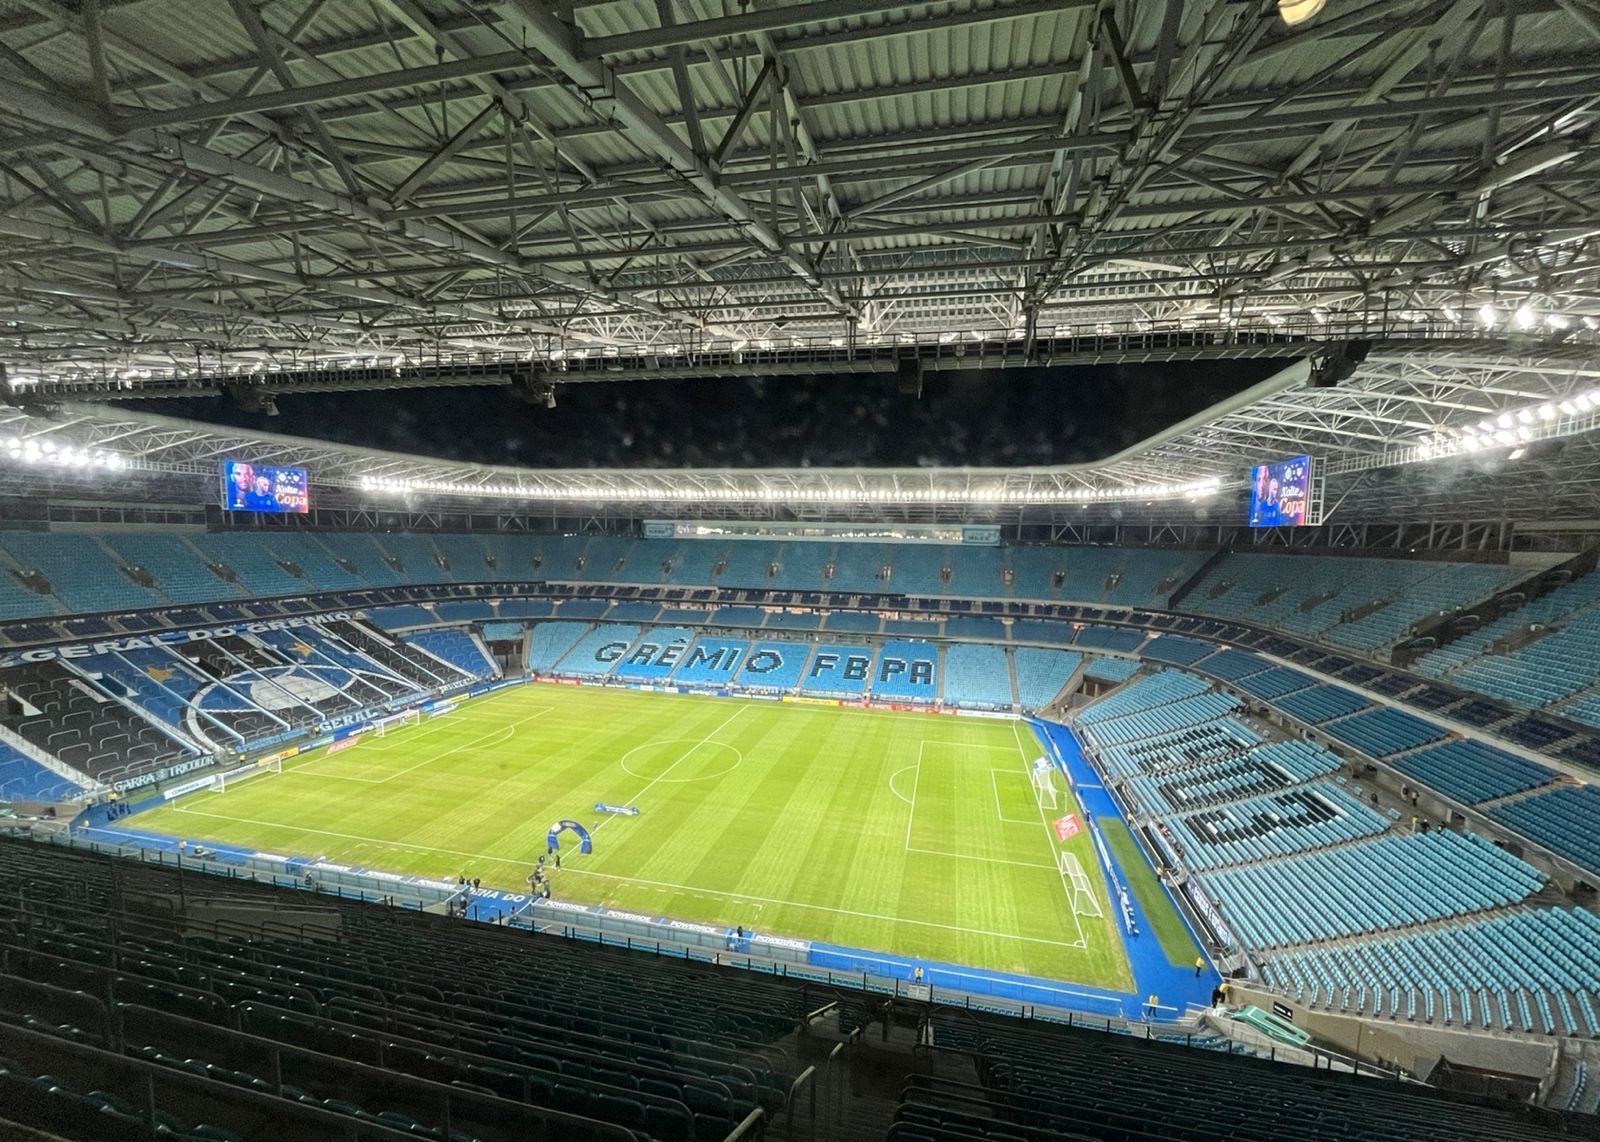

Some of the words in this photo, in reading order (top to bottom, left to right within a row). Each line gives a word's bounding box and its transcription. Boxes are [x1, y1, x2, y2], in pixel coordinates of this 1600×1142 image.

[274, 492, 306, 507] Copa
[1280, 498, 1305, 517] Copa
[21, 637, 174, 661] GERAL
[188, 626, 236, 641] DO
[247, 612, 350, 633] GREMIO
[595, 638, 784, 674] GRÊMIO
[810, 653, 935, 685] FBPA
[319, 708, 379, 732] GERAL
[113, 773, 156, 793] GARRA
[168, 755, 215, 777] TRICOLOR
[503, 894, 526, 902] DO
